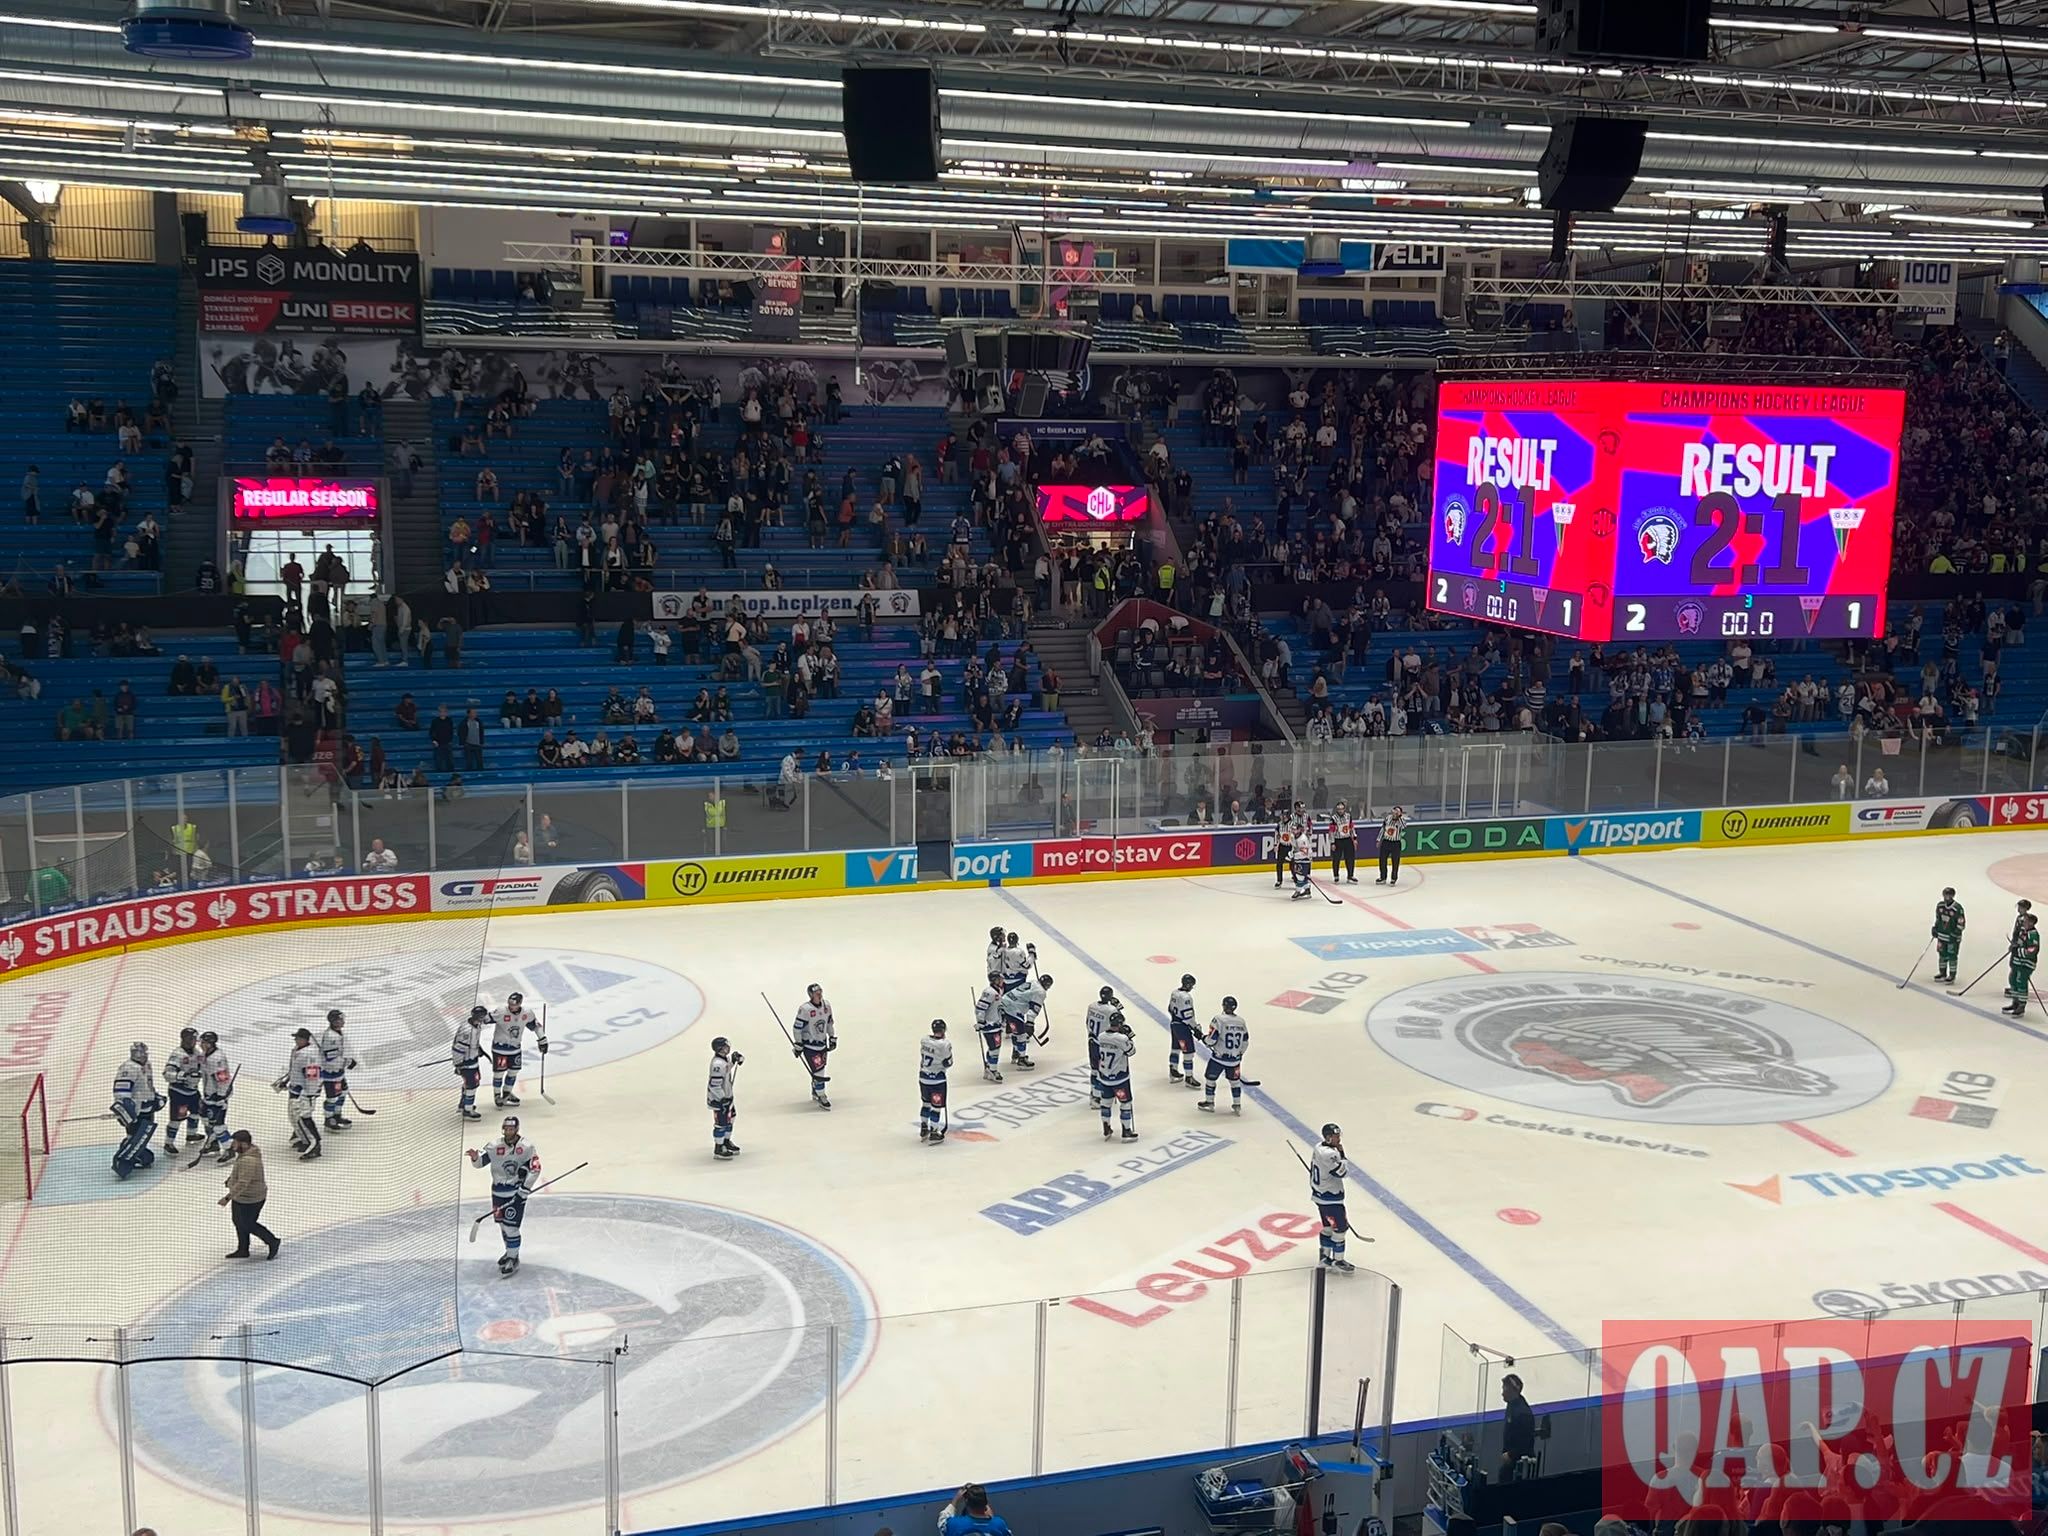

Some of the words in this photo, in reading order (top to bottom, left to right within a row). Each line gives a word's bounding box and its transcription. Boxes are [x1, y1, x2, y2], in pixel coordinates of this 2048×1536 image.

[205, 258, 248, 277] JPS
[293, 261, 412, 283] MONOLITY
[1904, 262, 1951, 284] 1000
[759, 305, 794, 316] 2019/20
[1660, 390, 1749, 409] CHAMPIONS
[1753, 392, 1810, 410] HOCKEY
[1813, 394, 1865, 412] LEAGUE
[1466, 436, 1558, 491] RESULT
[1680, 442, 1836, 498] RESULT
[242, 489, 309, 506] REGULAR
[310, 490, 368, 507] SEASON
[1090, 492, 1111, 515] CHL
[1471, 482, 1540, 576] 2:1
[1690, 491, 1809, 585] 2:1
[1436, 578, 1448, 603] 2
[1500, 580, 1506, 594] 3
[1486, 594, 1518, 622] 00.0
[1563, 600, 1572, 627] 1
[1745, 594, 1753, 608] 3
[1625, 603, 1646, 632] 2
[1721, 612, 1774, 636] 00.0
[1848, 602, 1861, 629] 1
[1751, 815, 1831, 829] WARRIOR
[1858, 808, 1895, 821] GT
[1589, 816, 1685, 846] Tipsport
[1169, 842, 1201, 861] CZ
[713, 867, 819, 884] WARRIOR
[898, 849, 1012, 881] Tiport
[440, 880, 496, 896] GT
[496, 882, 540, 890] RADIAL
[248, 882, 418, 920] STRAUSS
[35, 901, 198, 956] STRAUSS
[1344, 934, 1462, 951] Tipsport
[1579, 954, 1710, 976] oneplay
[1309, 971, 1369, 994] KB
[1225, 1032, 1242, 1050] 63
[1941, 1070, 1997, 1100] KB
[1485, 1113, 1575, 1136] Česká
[1583, 1131, 1711, 1159] televize
[1789, 1153, 2047, 1198] Tipsport
[1068, 1211, 1325, 1329] Leuze
